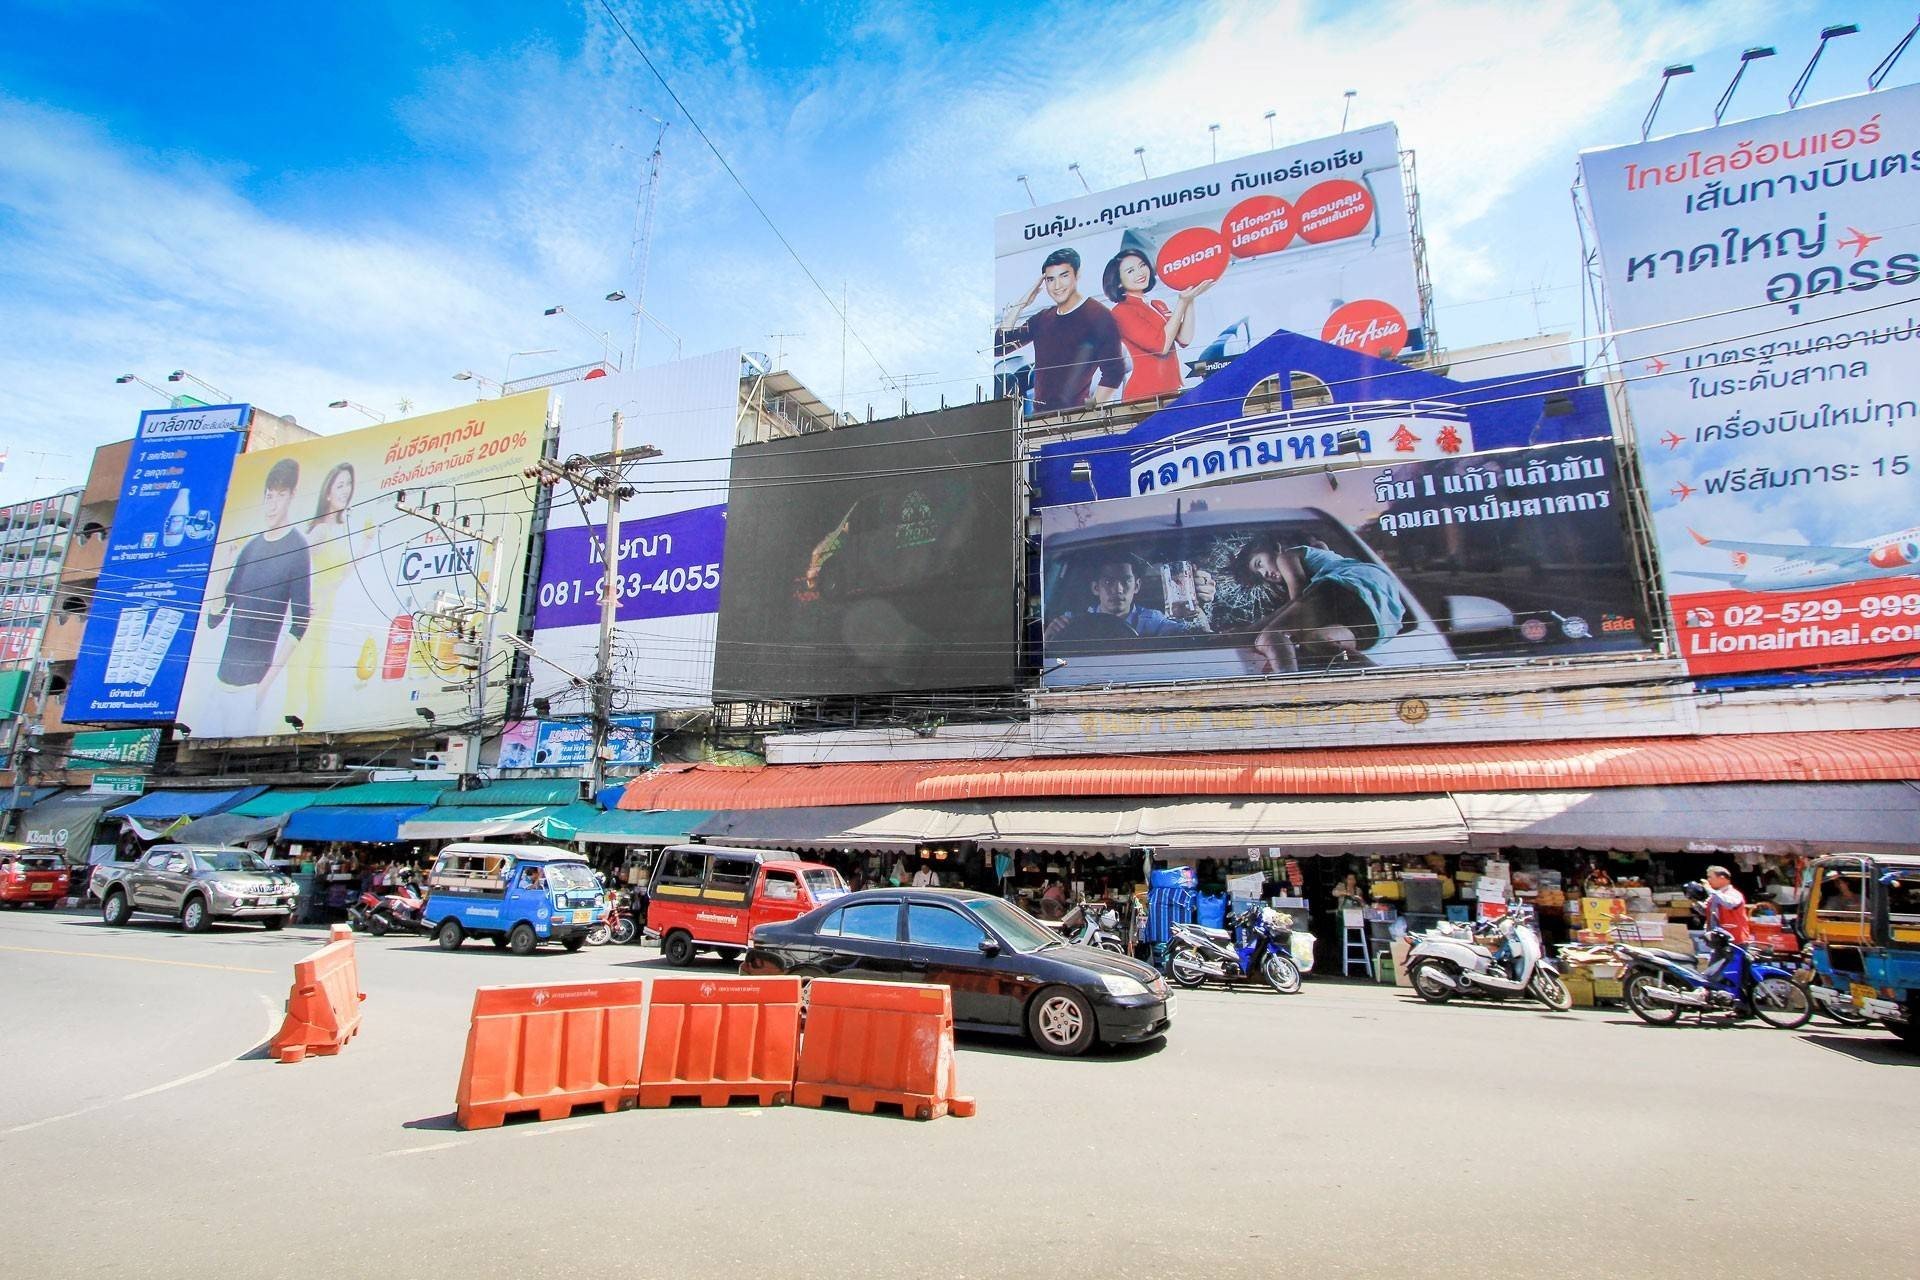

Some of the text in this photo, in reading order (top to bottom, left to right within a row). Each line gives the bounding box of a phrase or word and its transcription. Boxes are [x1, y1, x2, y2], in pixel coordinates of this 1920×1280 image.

[1231, 149, 1363, 192] กับแอร์เอเชีย
[1625, 114, 1882, 191] ไทยไลอ้อนแอร์
[1301, 192, 1362, 222] ครอบคลุม
[1303, 203, 1365, 233] หลายเส้นทาง
[1231, 219, 1288, 248] ปลอดภัย
[1626, 212, 1827, 282] หาดใหญ่
[1163, 245, 1221, 275] ตรงเวลา
[1689, 358, 1868, 399] ในระดับสากล
[1695, 399, 1920, 443] เครื่องบินใหม่ทุก
[477, 430, 527, 460] 200%
[128, 485, 138, 496] 3
[132, 468, 143, 480] 2
[1375, 469, 1415, 502] ดื่ม
[1443, 467, 1497, 494] แก้ว
[1505, 455, 1605, 487] แล้วขับ
[1705, 455, 1909, 495] ฟรีสัมภาระ 15
[1379, 489, 1610, 537] คุณอาจเป็นฆาตกร
